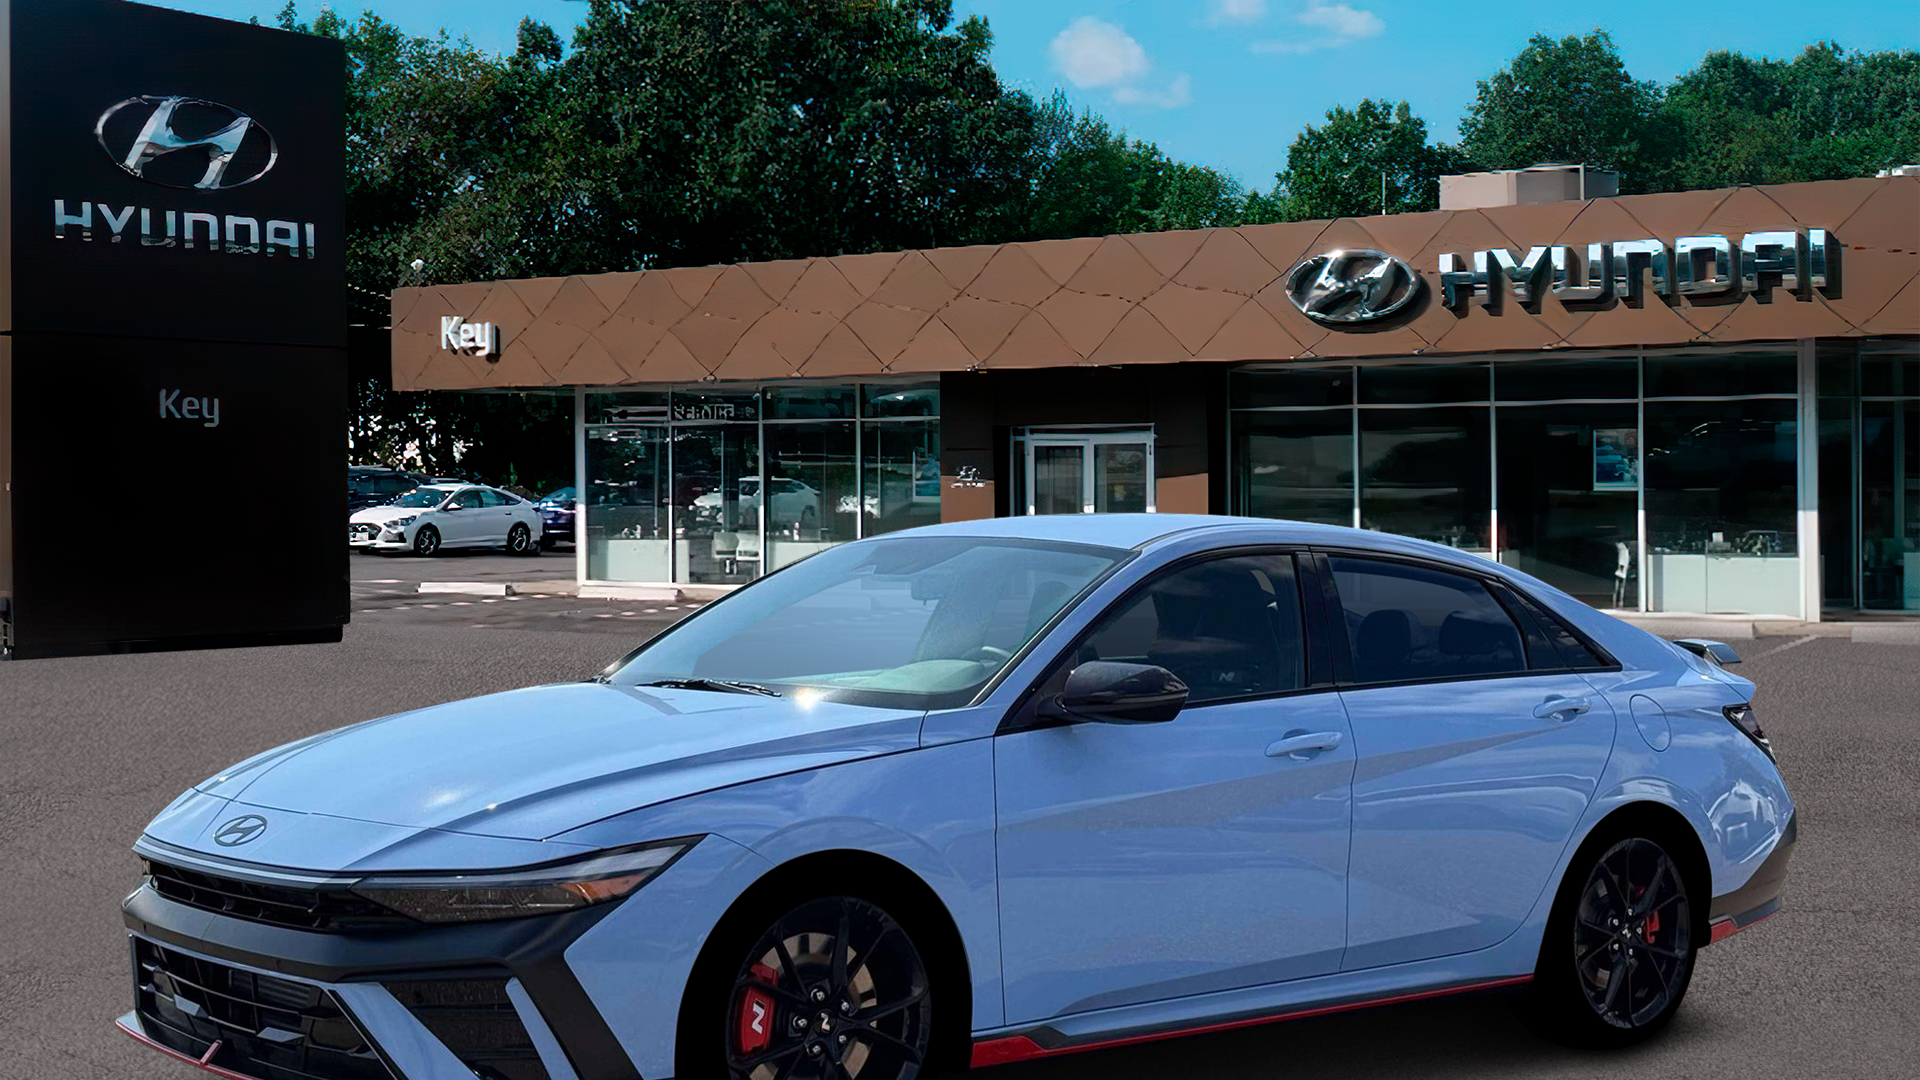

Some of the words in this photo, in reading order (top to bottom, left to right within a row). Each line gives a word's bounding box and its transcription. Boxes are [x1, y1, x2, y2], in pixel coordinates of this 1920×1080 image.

[54, 199, 315, 260] HYUNDAI
[1438, 228, 1842, 317] HYUNDAI
[441, 315, 494, 357] Key
[159, 388, 220, 428] Key
